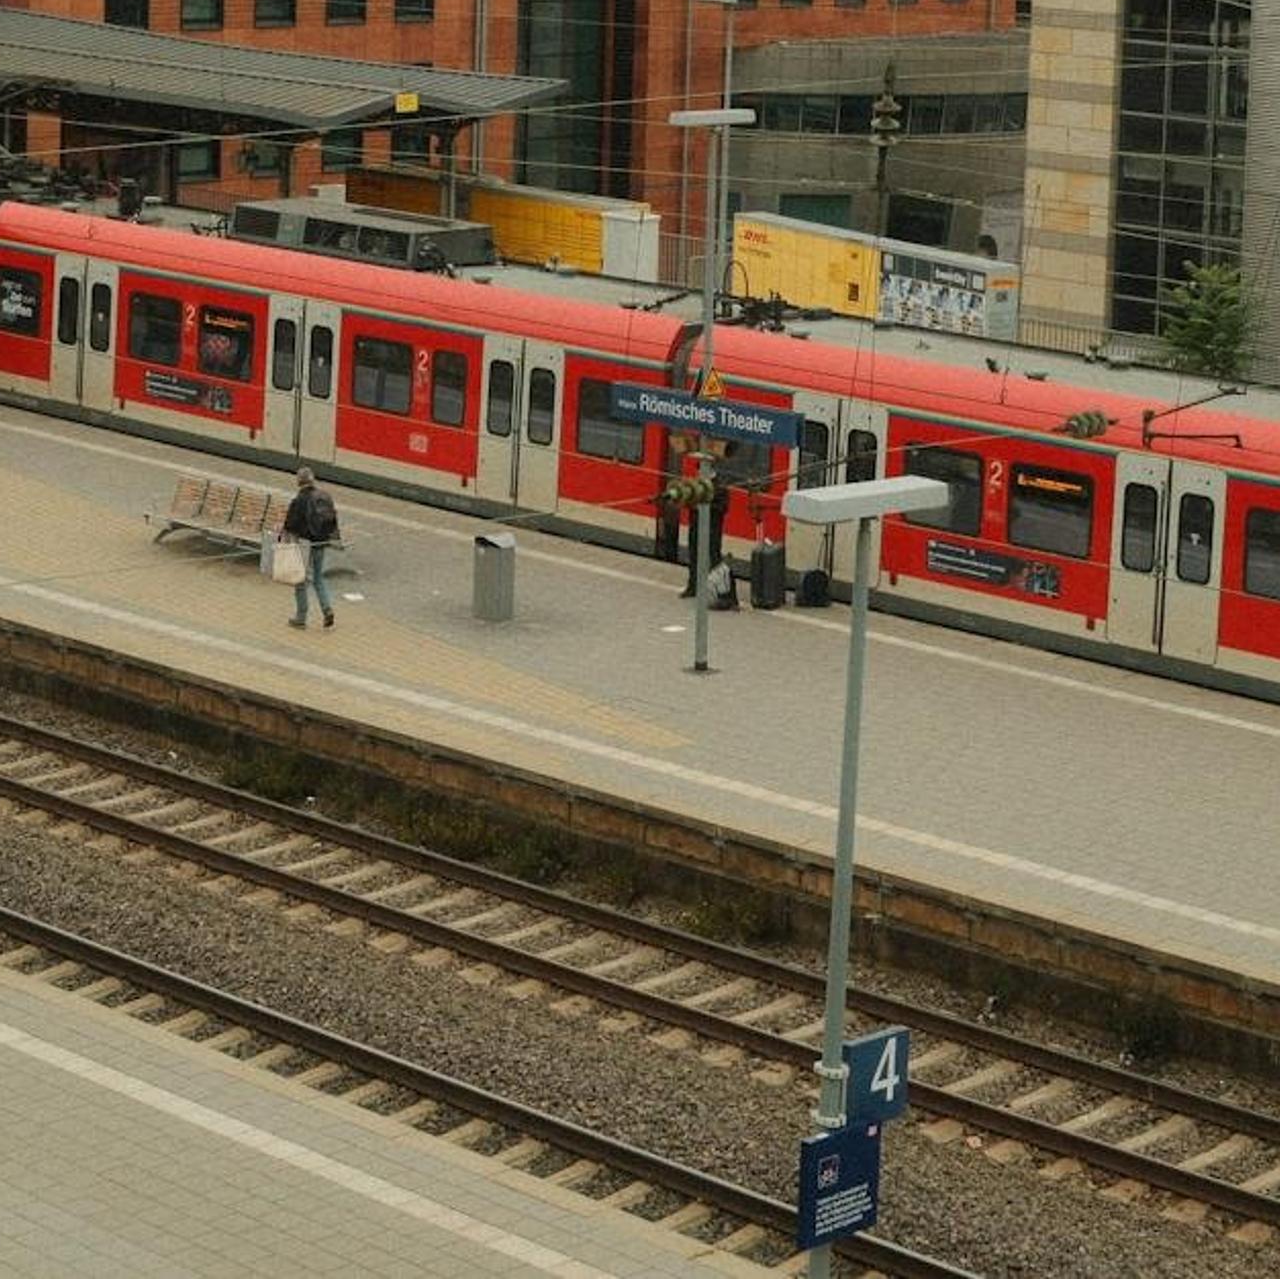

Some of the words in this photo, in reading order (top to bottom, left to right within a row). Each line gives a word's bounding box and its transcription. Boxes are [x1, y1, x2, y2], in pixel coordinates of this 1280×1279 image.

[185, 304, 196, 326] 2
[417, 349, 429, 371] 2
[639, 393, 716, 424] Römisches
[718, 406, 774, 434] Theater
[989, 460, 1003, 487] 2
[870, 1036, 900, 1102] 4
